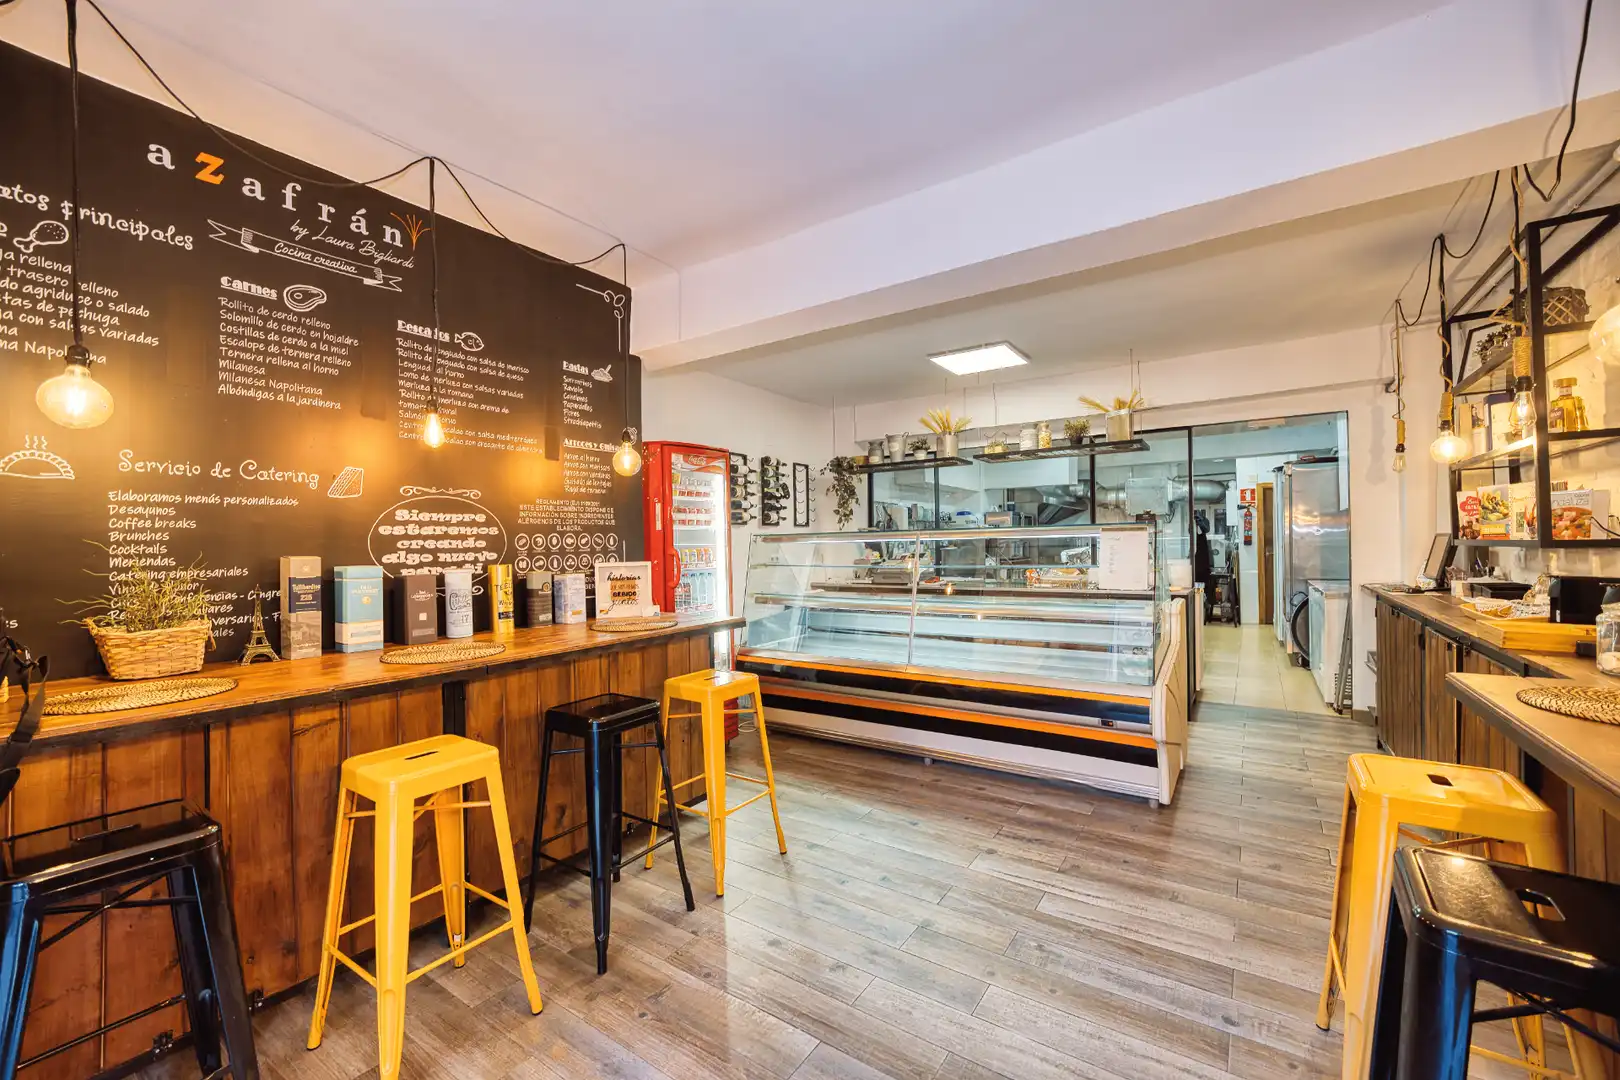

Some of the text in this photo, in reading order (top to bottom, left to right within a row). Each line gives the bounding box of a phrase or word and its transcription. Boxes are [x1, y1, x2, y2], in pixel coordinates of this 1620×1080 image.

[290, 220, 415, 269] by Laura Bigliardi
[20, 254, 72, 274] rellena
[274, 242, 358, 274] Cocina creativa
[7, 265, 69, 286] trasero
[78, 282, 118, 298] elleno
[220, 276, 278, 299] Carnes
[22, 284, 92, 306] agridue
[108, 302, 150, 317] salado
[37, 300, 55, 313] de
[218, 296, 330, 330] Rollito de cerdo relleno
[19, 314, 44, 325] con
[50, 318, 96, 335] salas
[220, 310, 263, 326] Solomillo
[266, 320, 279, 330] de
[281, 324, 307, 335] cerdo
[323, 331, 359, 347] hojaldre
[220, 322, 265, 339] Costillas
[282, 336, 308, 348] cerdo
[320, 341, 328, 351] la
[331, 344, 349, 355] miel
[396, 338, 422, 350] Rollito
[424, 344, 432, 352] de
[25, 341, 106, 364] Napolna
[220, 335, 351, 367] Escalope de ternera relleno
[396, 348, 422, 359] Rollito
[436, 358, 465, 369] enguado
[218, 358, 265, 375] Milanesa
[220, 346, 339, 376] Ternera rellena al horno
[399, 358, 431, 371] Lenguad
[218, 371, 322, 395] Milanesa Napolitana
[399, 369, 418, 379] Lomo
[421, 373, 430, 381] de
[218, 384, 274, 401] Albóndigas
[286, 393, 295, 403] la
[296, 395, 341, 410] jardinera
[443, 427, 463, 435] acalao
[118, 449, 319, 490] Servicio de Catering
[108, 490, 299, 507] Elaboramos menús personalizados
[108, 505, 176, 518] Desayunos
[394, 509, 486, 523] Siempre
[109, 518, 196, 530] Coffee breaks
[378, 524, 499, 535] estaremos
[108, 530, 169, 542] Brunches
[396, 537, 486, 549] creando
[109, 544, 167, 554] Cocktails
[109, 556, 176, 568] Meriendas
[381, 551, 498, 565] algo nuevo
[109, 566, 249, 581] Cateing empresariales
[400, 566, 456, 576] par
[247, 590, 281, 601] Cngre
